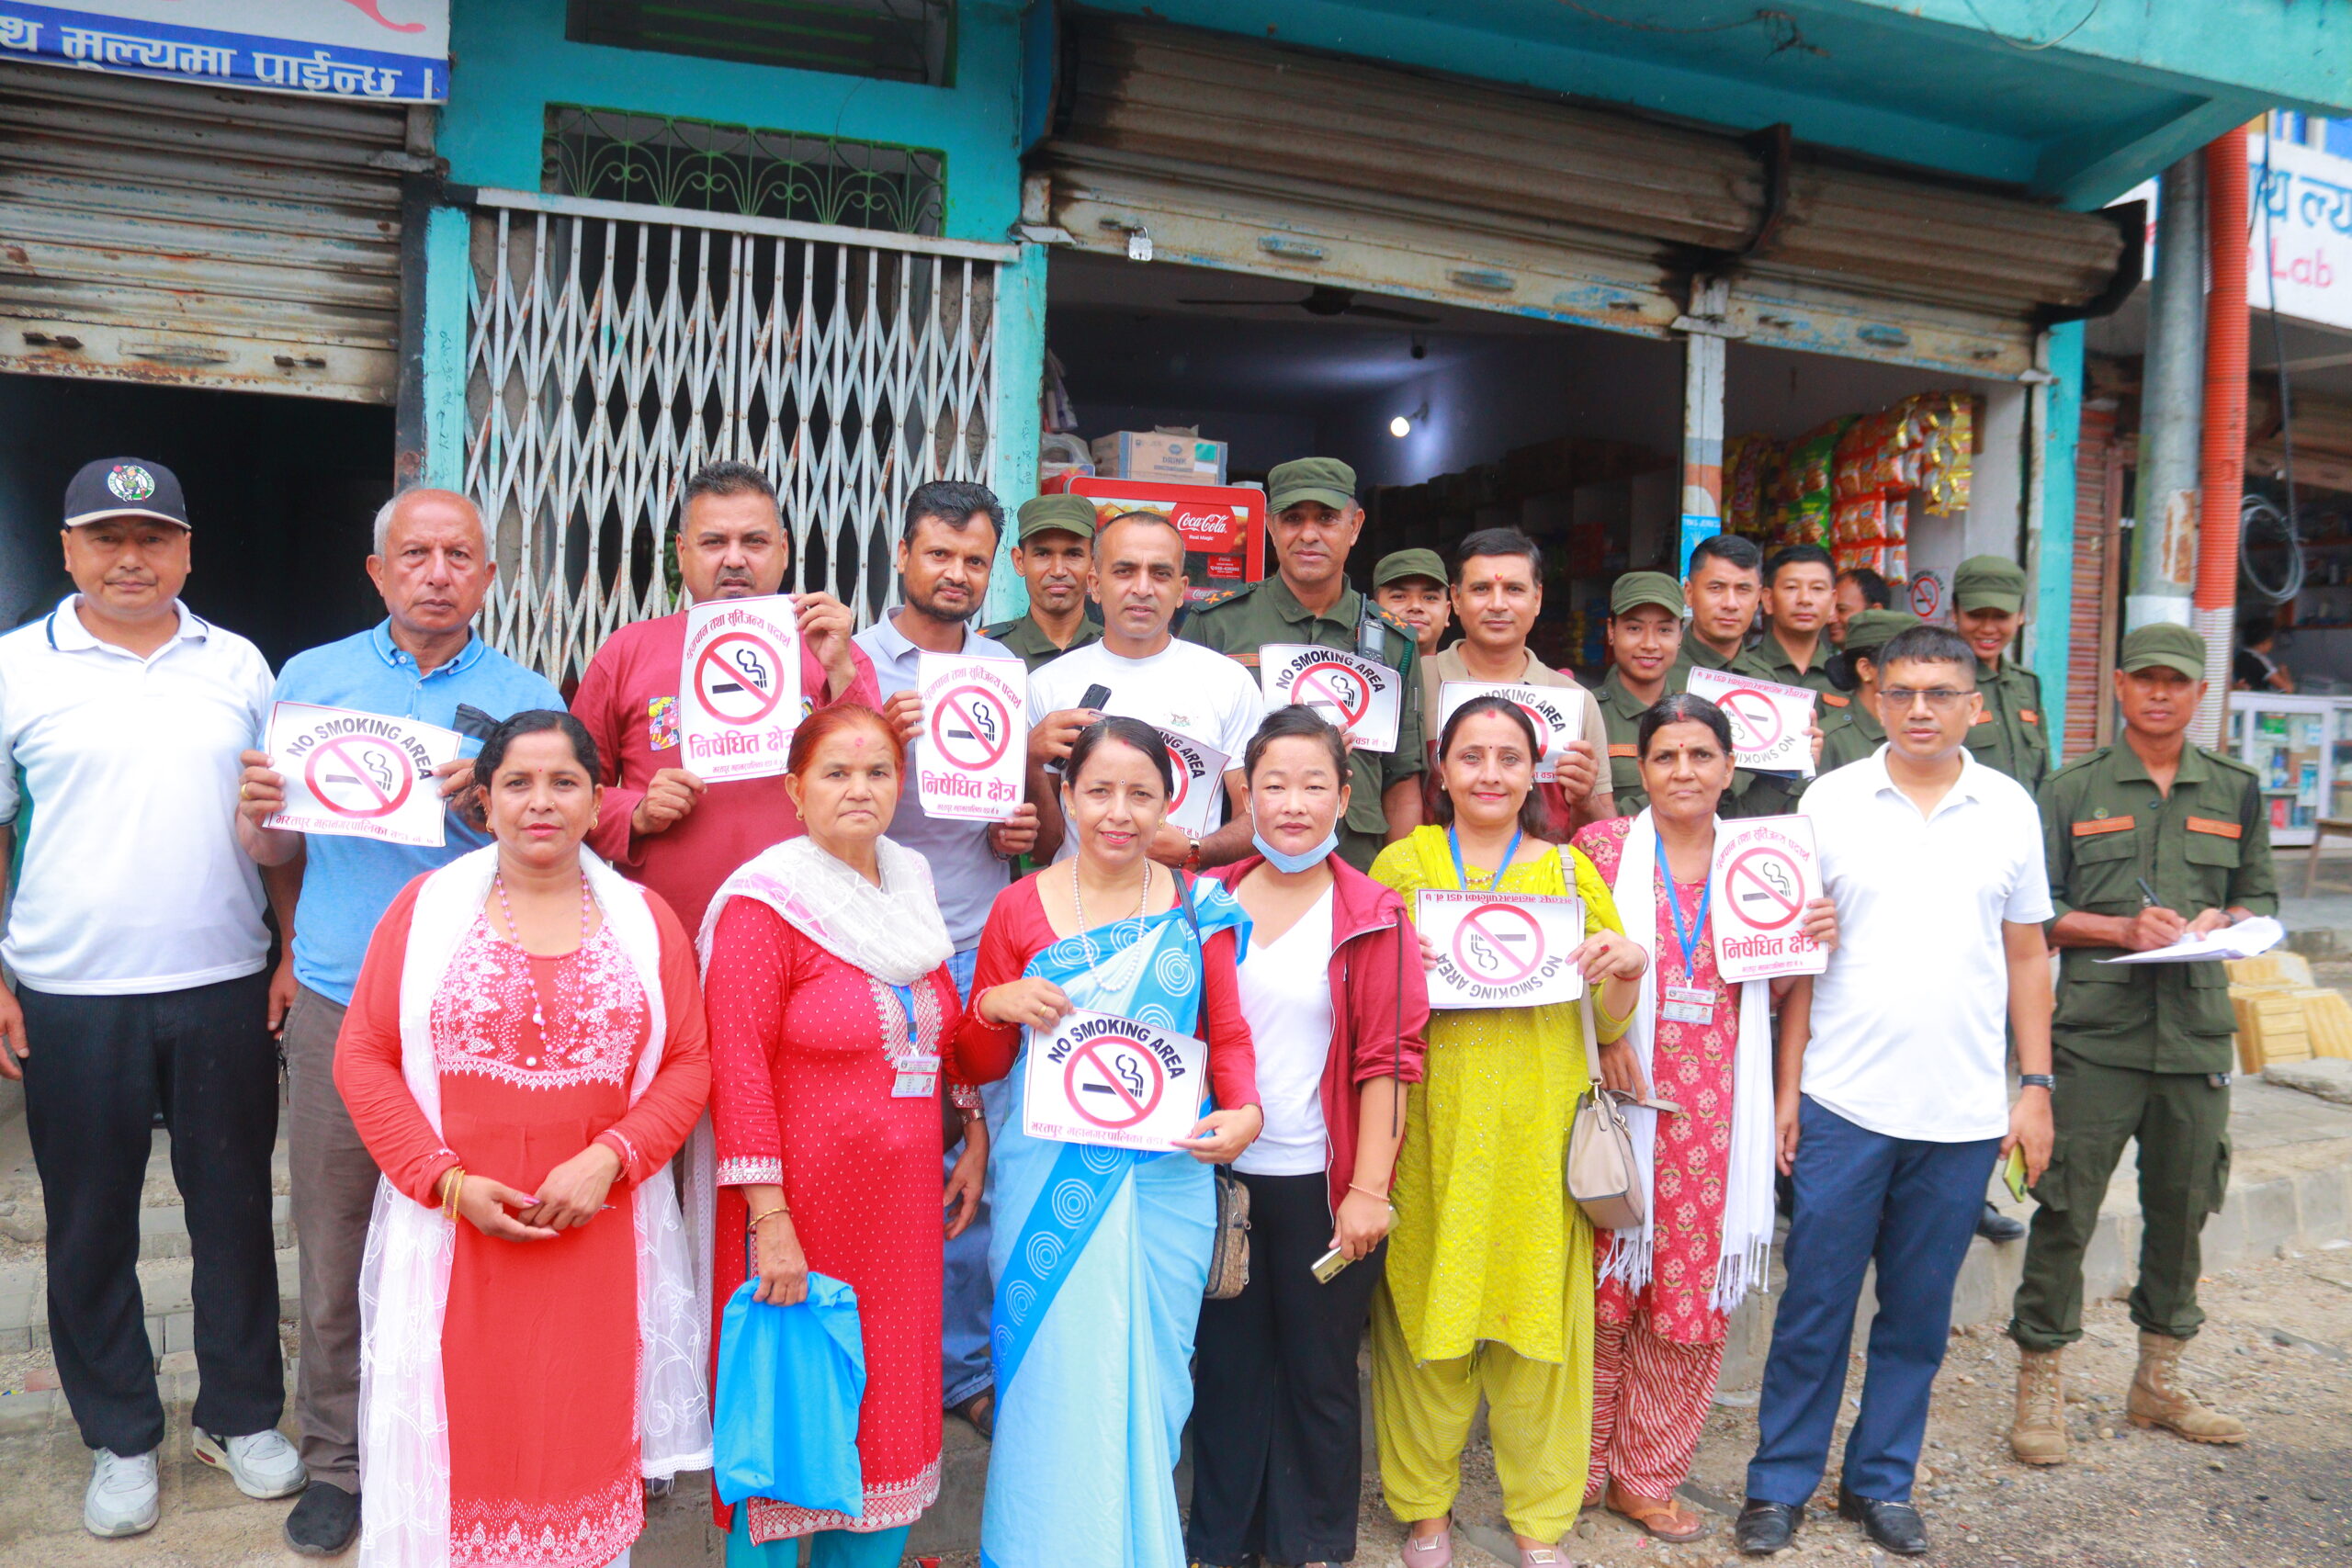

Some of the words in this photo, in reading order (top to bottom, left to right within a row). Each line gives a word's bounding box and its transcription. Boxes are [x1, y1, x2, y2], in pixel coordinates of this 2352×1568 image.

[2271, 237, 2335, 288] Lab
[1177, 513, 1229, 534] Coca-Cola
[1276, 669, 1295, 690] NO
[1291, 650, 1353, 671] SMOKING
[1355, 664, 1385, 694] AREA
[1535, 700, 1566, 733] AREA
[286, 736, 314, 758] NO
[314, 718, 402, 741] SMOKING
[400, 736, 434, 781] AREA
[689, 730, 761, 760] निषेधित
[1779, 736, 1796, 752] NO
[1180, 747, 1205, 779] AREA
[922, 770, 982, 798] निषेधित
[988, 777, 1017, 802] क्षेत्र
[276, 815, 311, 829] भरतपुर
[1723, 934, 1783, 960] निषेधित
[1436, 953, 1466, 991] AREA
[1542, 954, 1563, 978] NO
[1469, 976, 1544, 1000] SMOKING
[1047, 1037, 1071, 1065] NO
[1070, 1019, 1151, 1043] SMOKING
[1148, 1038, 1186, 1079] AREA
